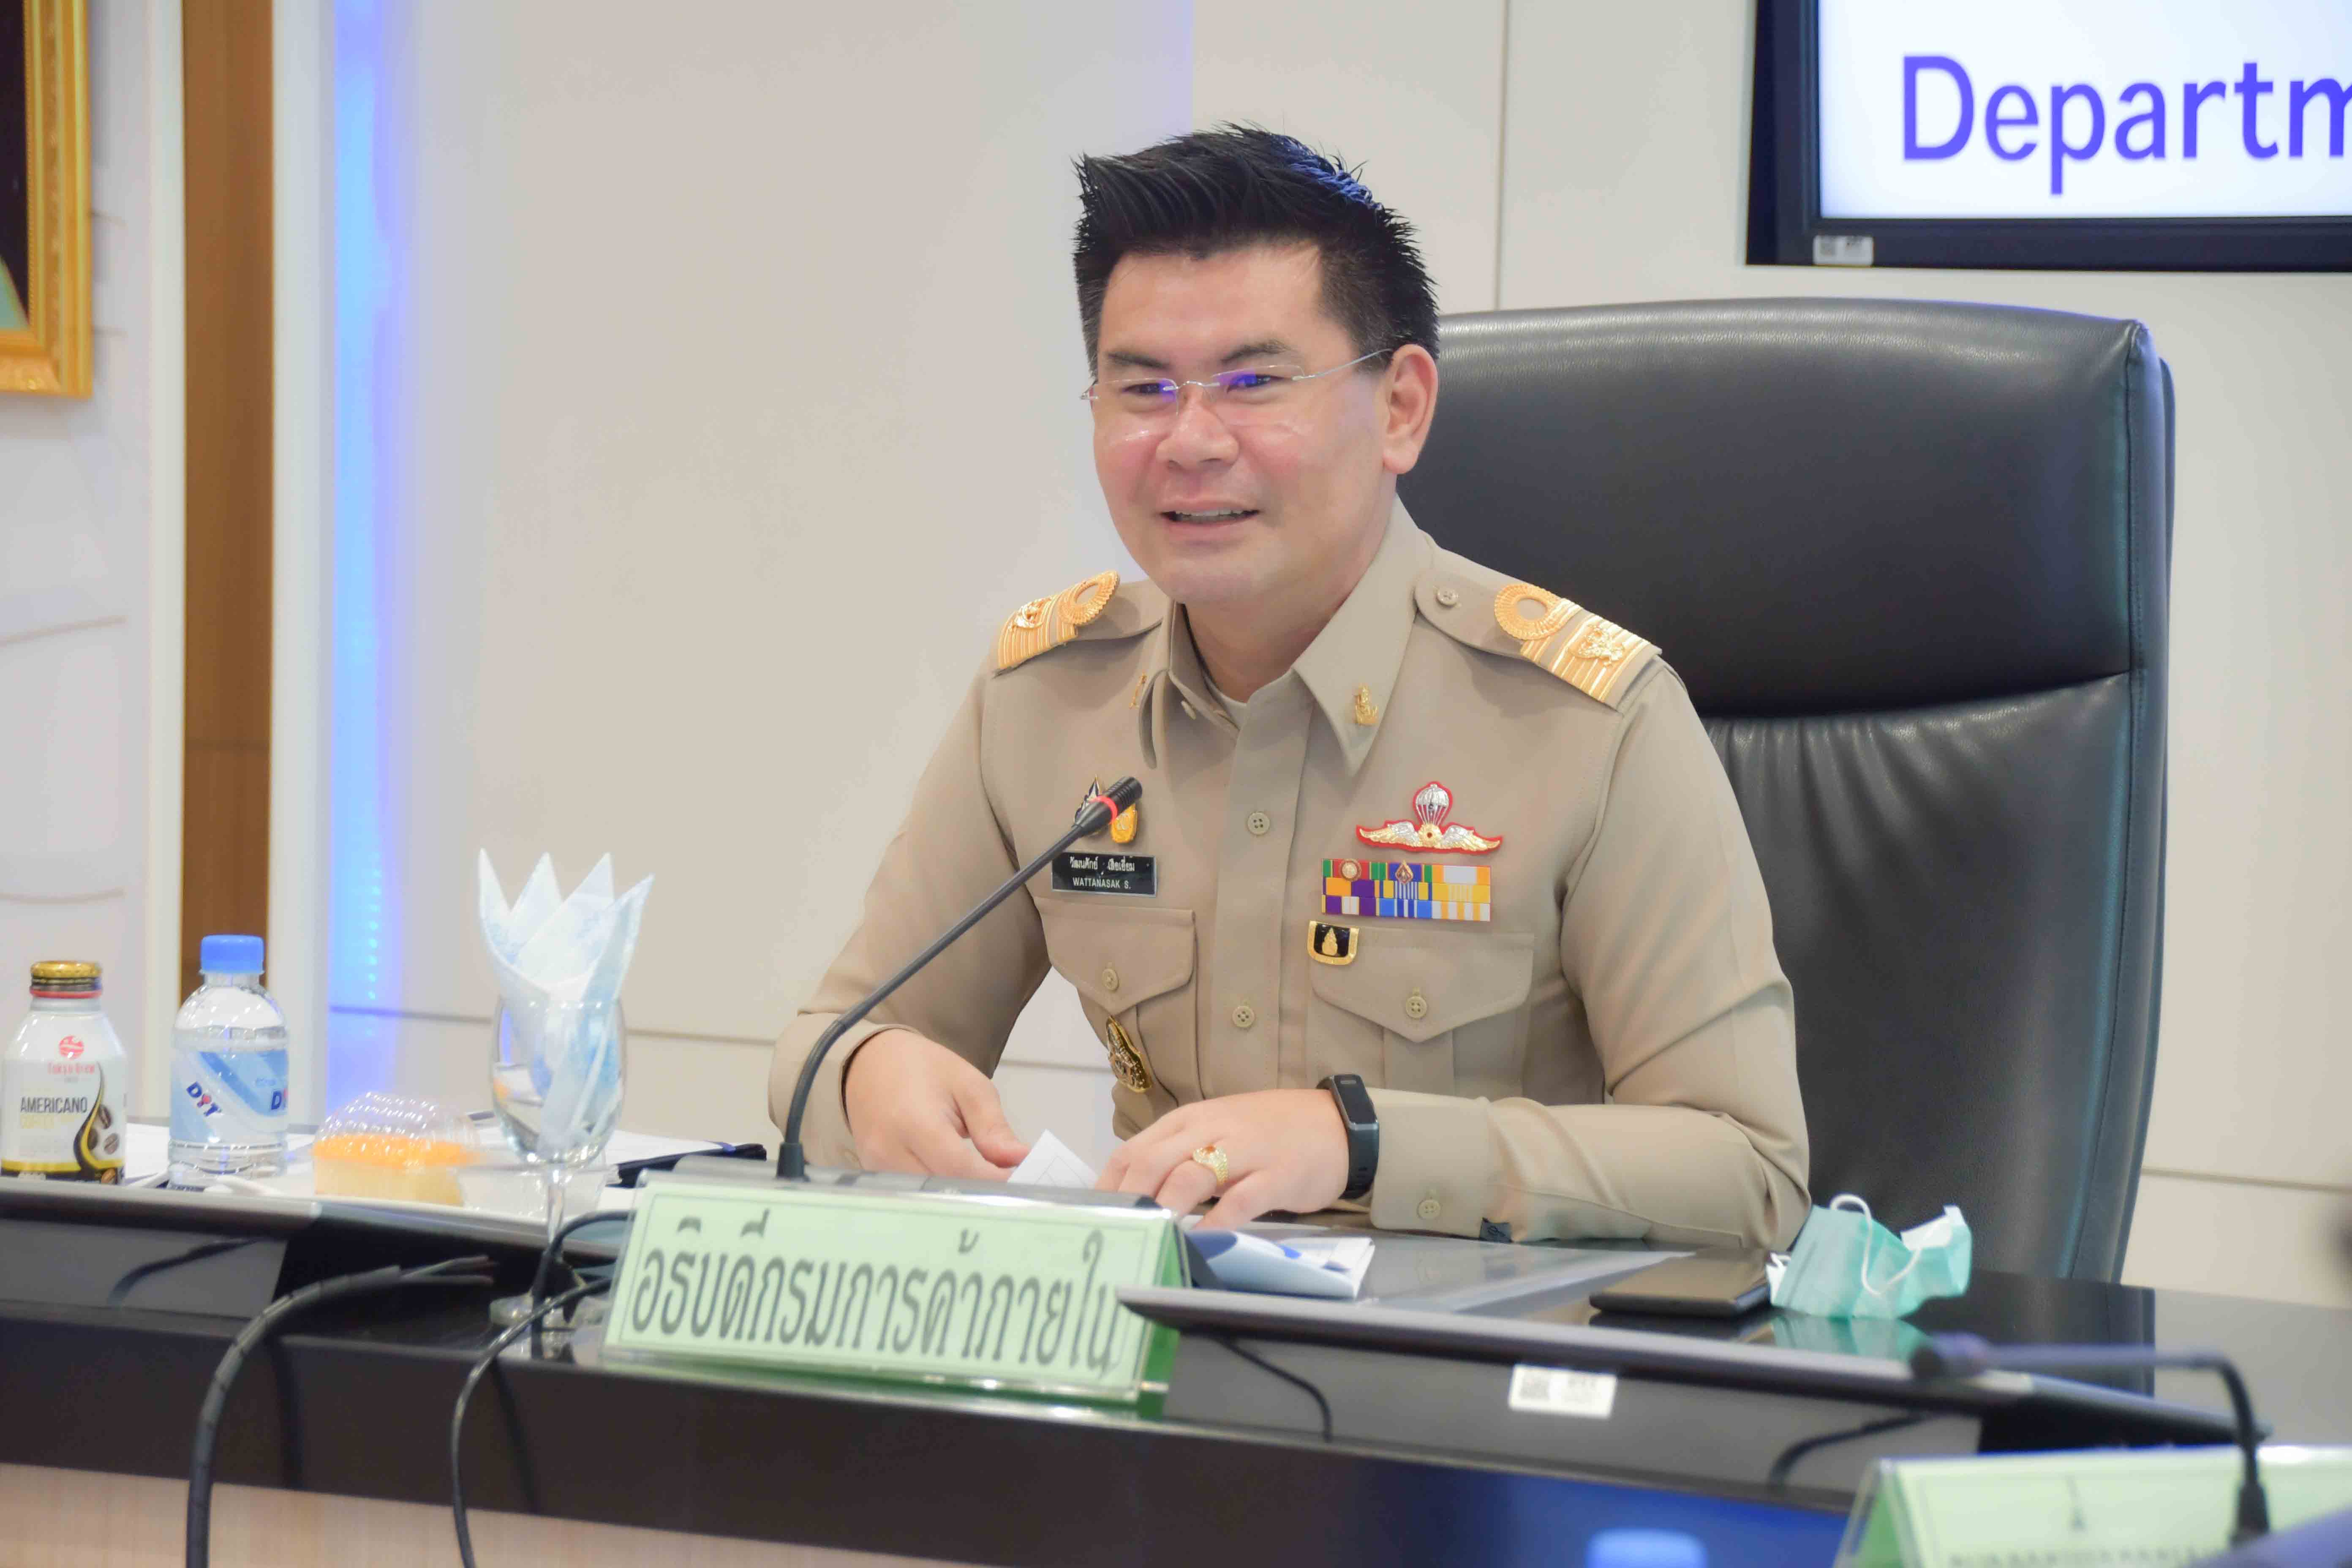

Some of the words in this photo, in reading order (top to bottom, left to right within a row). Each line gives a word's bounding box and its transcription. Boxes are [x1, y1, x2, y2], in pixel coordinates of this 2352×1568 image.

[1073, 877, 1120, 888] WATTANASAK
[1124, 880, 1131, 889] S.
[21, 1097, 88, 1113] AMERICANO
